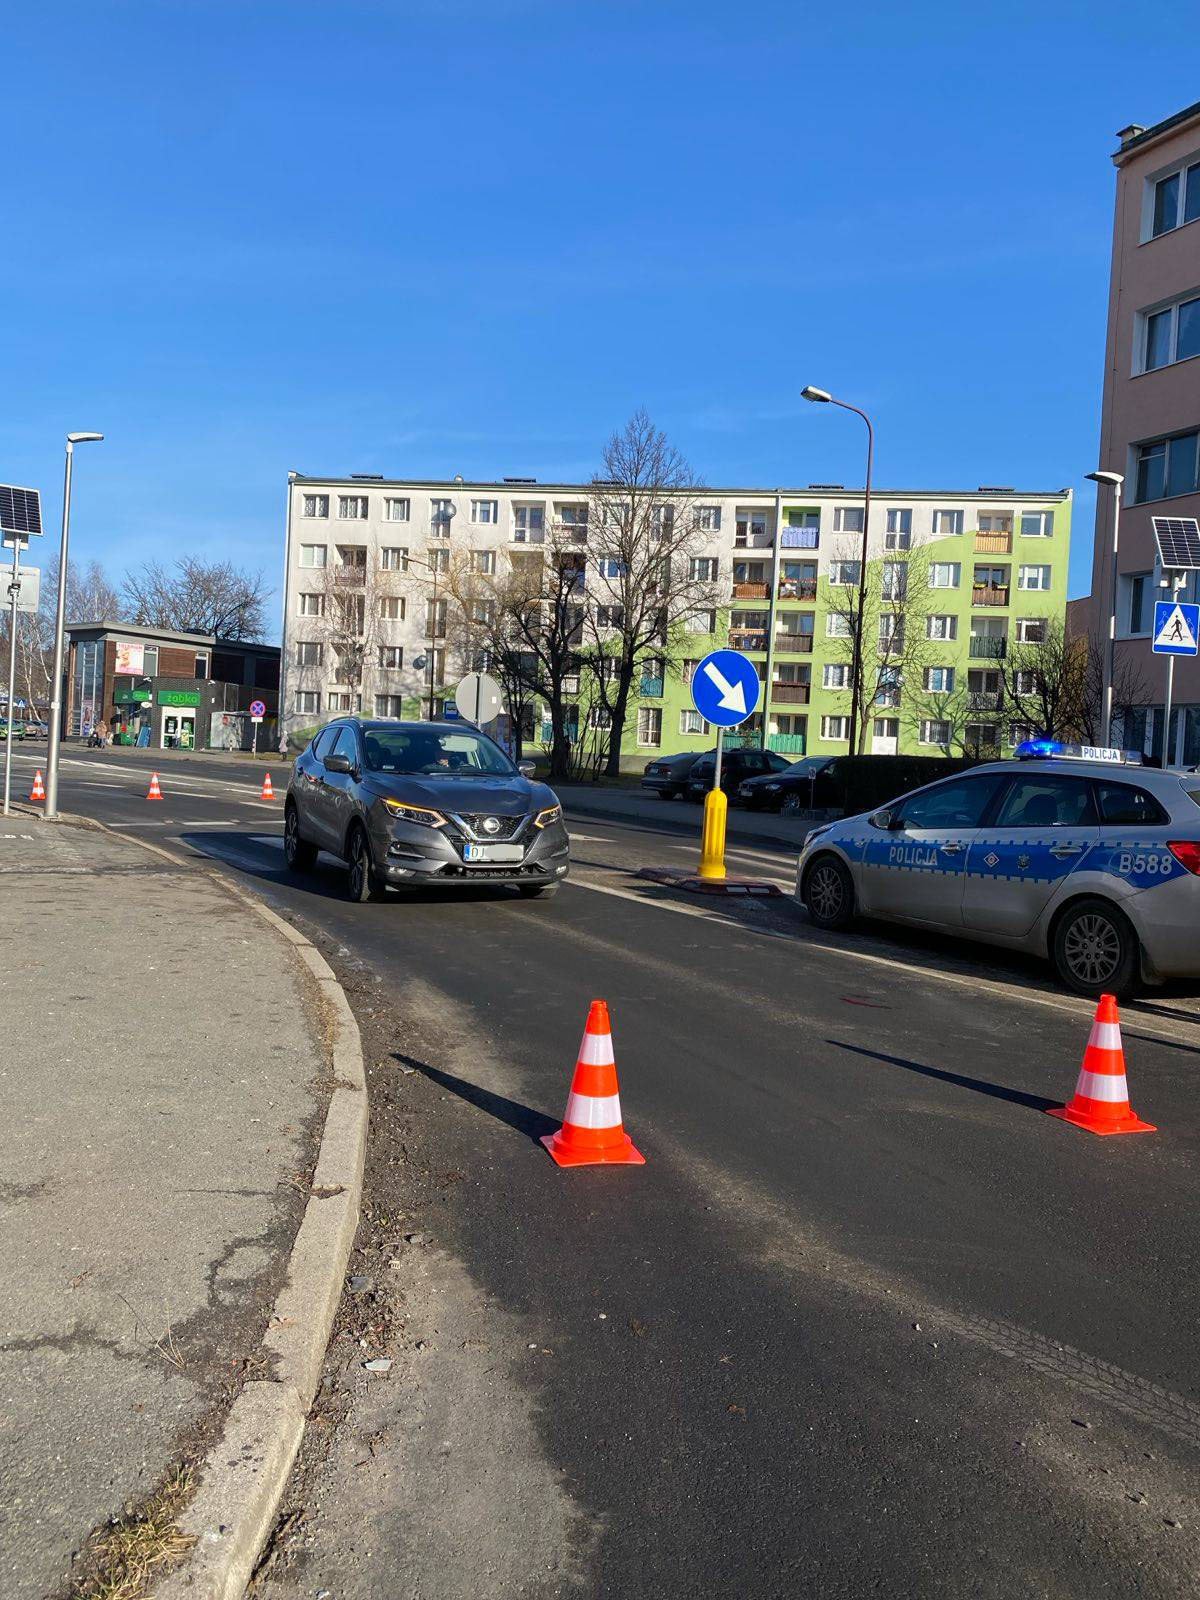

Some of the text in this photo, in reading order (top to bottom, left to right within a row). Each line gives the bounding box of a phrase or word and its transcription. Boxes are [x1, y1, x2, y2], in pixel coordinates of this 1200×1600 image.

[1083, 747, 1118, 760] POLICJA
[889, 846, 938, 866] POLICJA
[1119, 853, 1173, 875] B588
